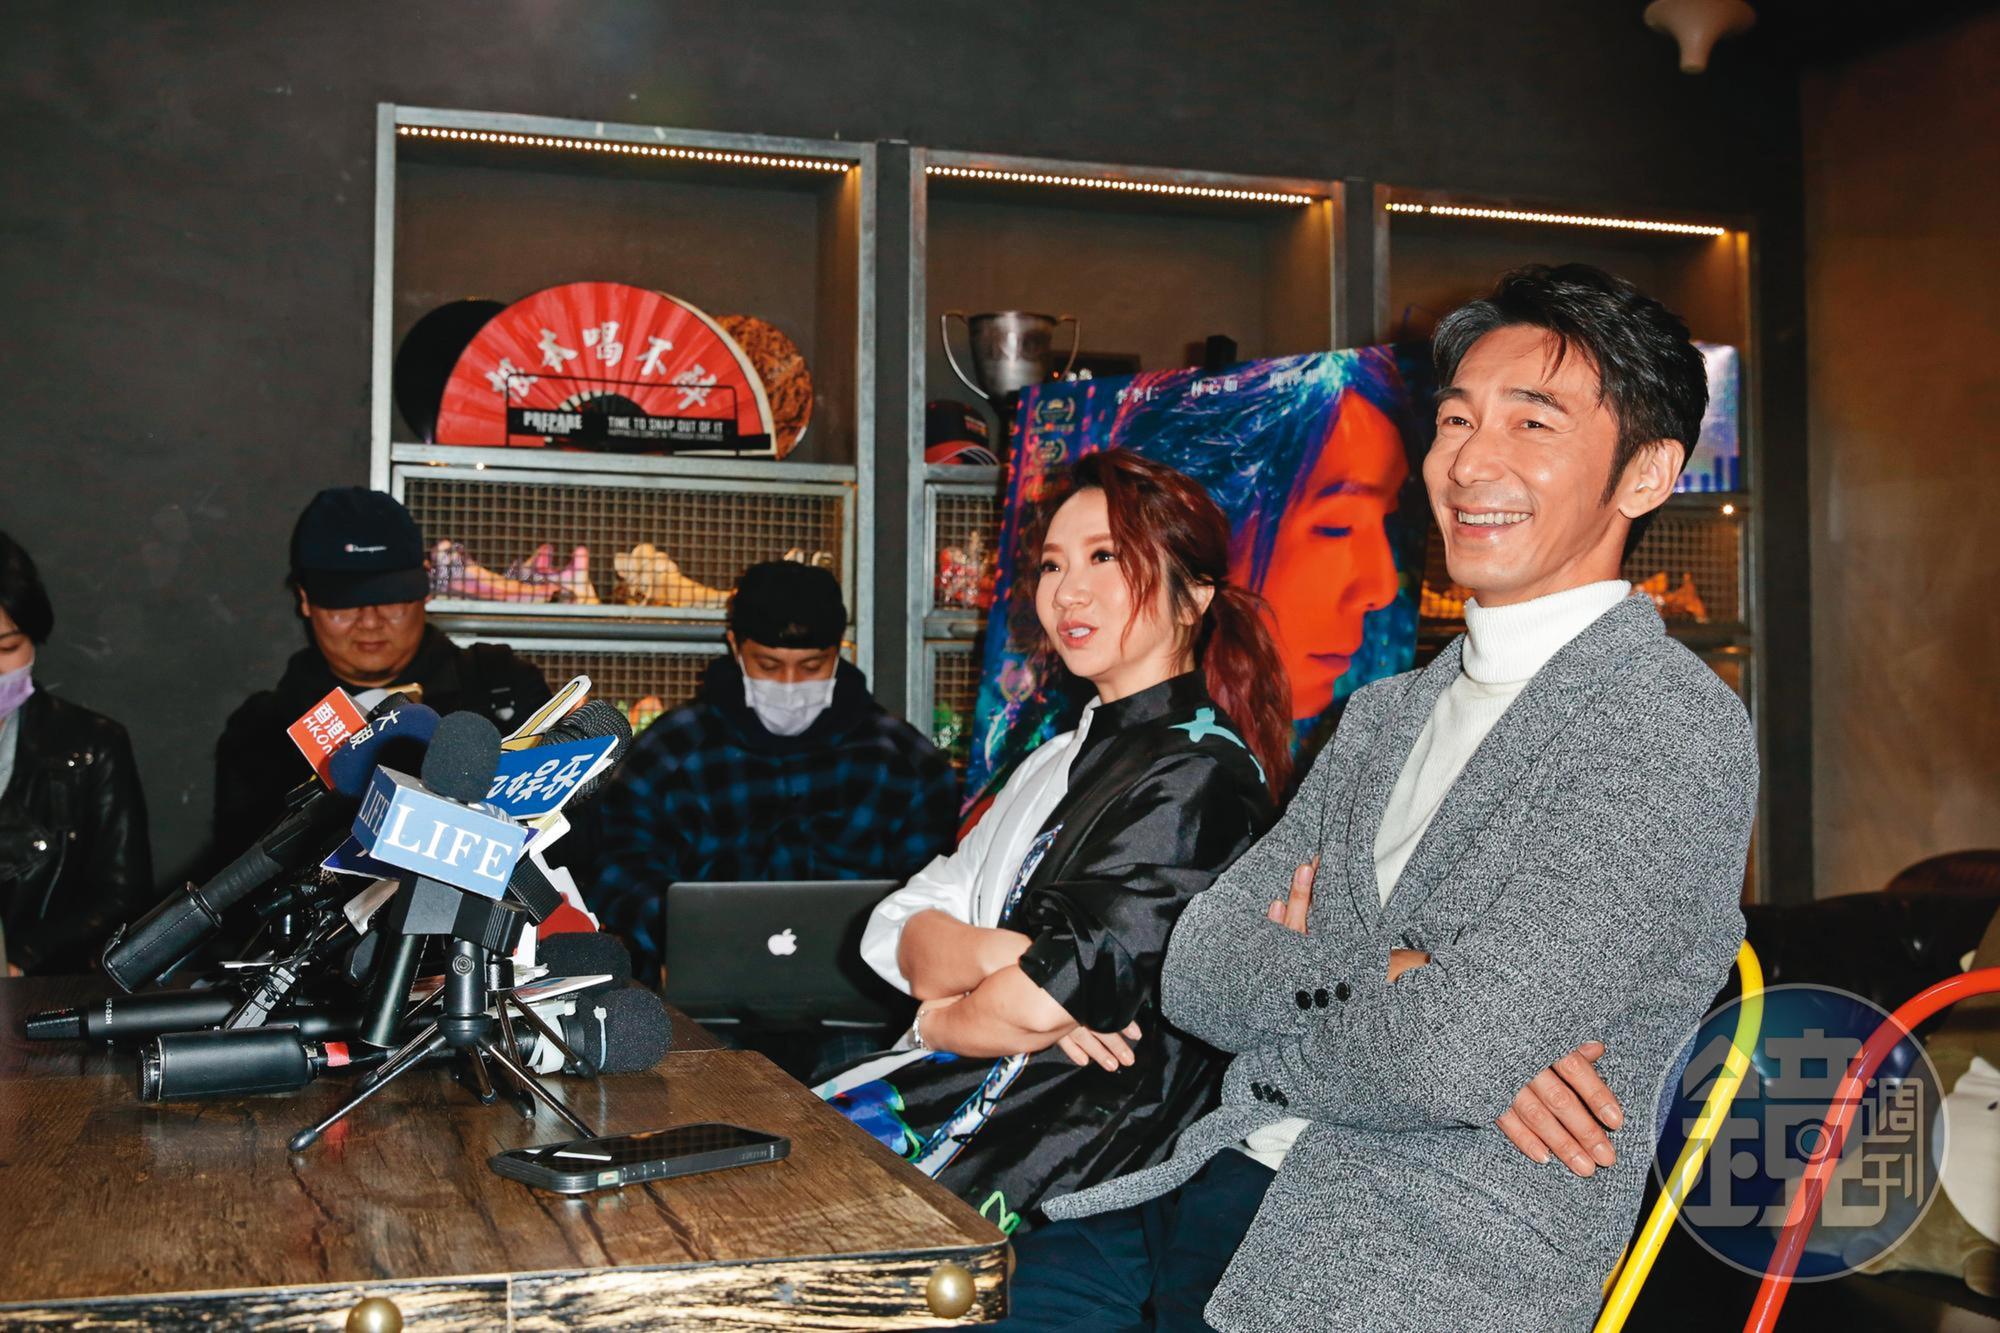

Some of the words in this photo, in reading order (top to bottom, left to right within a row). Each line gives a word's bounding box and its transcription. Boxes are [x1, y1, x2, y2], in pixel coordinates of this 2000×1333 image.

[608, 416, 630, 429] TIME
[633, 417, 646, 430] TO
[648, 418, 675, 431] SNAP
[677, 420, 696, 432] OUT
[698, 421, 711, 433] OF
[713, 422, 723, 433] IT
[358, 780, 390, 838] LIFE
[383, 803, 513, 882] LIFE
